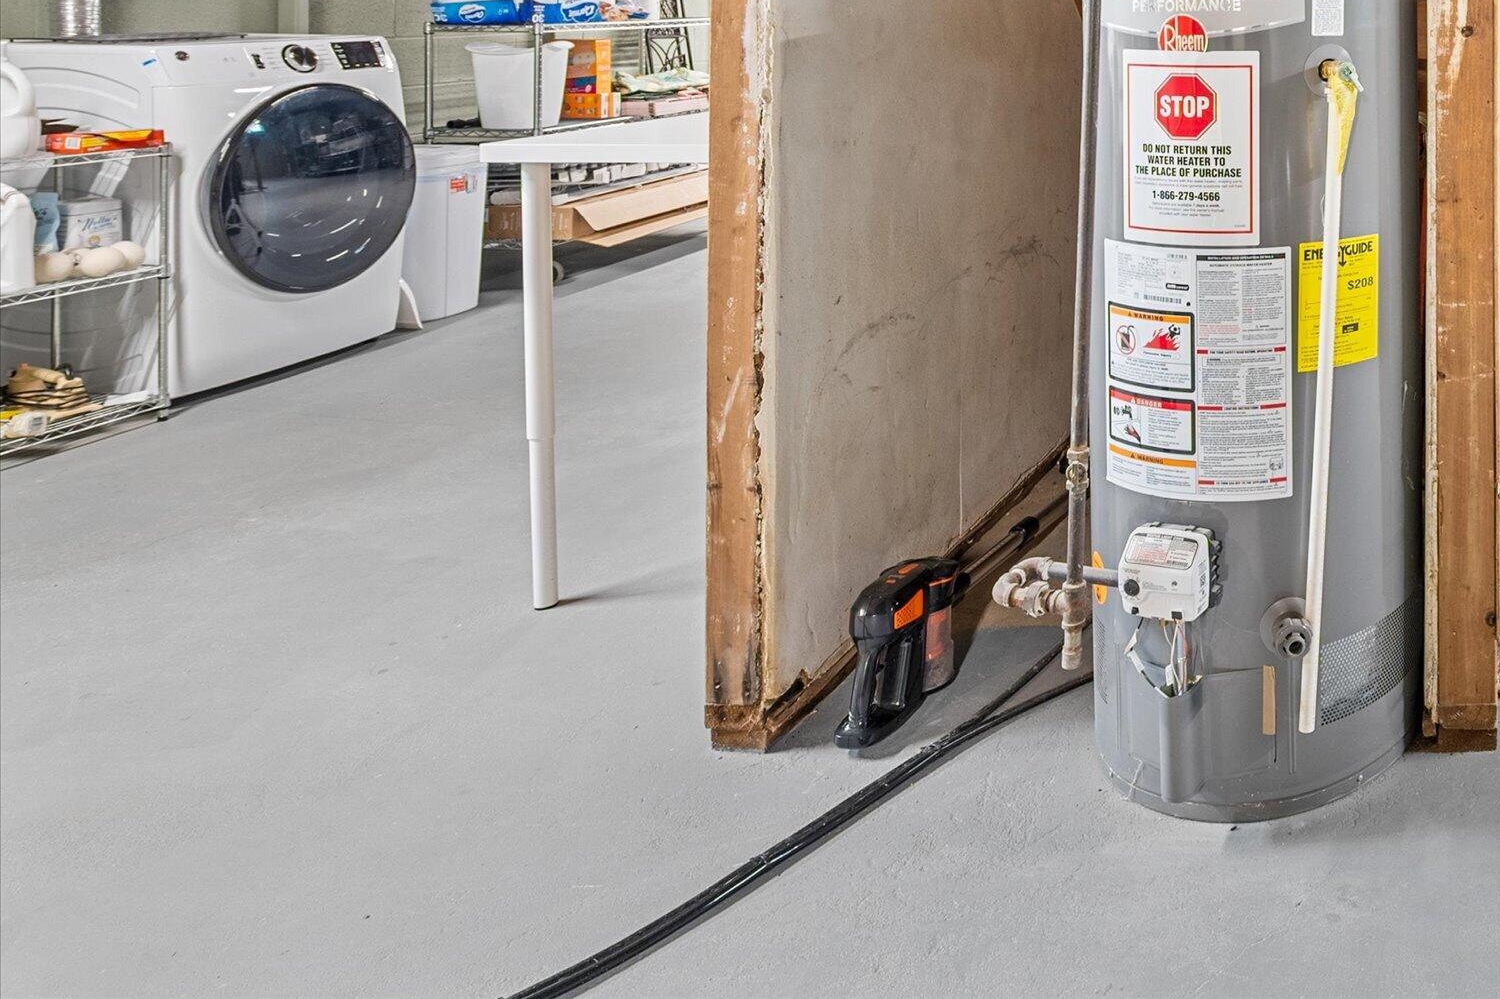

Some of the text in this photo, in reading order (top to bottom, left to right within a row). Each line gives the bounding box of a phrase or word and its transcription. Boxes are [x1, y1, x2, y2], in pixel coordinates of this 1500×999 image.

[532, 14, 545, 23] 30
[1163, 16, 1204, 51] Rheem
[1160, 95, 1210, 117] STOP
[1142, 143, 1232, 156] DO NOT RETURN THIS
[1147, 155, 1226, 167] WATER HEATER TO
[1135, 165, 1242, 178] THE PLACE OF PURCHASE
[1152, 190, 1221, 202] 1-866-279-4566
[1304, 241, 1373, 261] ENEYGUIDE
[1347, 276, 1374, 290] $208
[1134, 313, 1164, 321] WARNING
[1136, 399, 1162, 408] DANGER
[1137, 453, 1164, 464] WARNING
